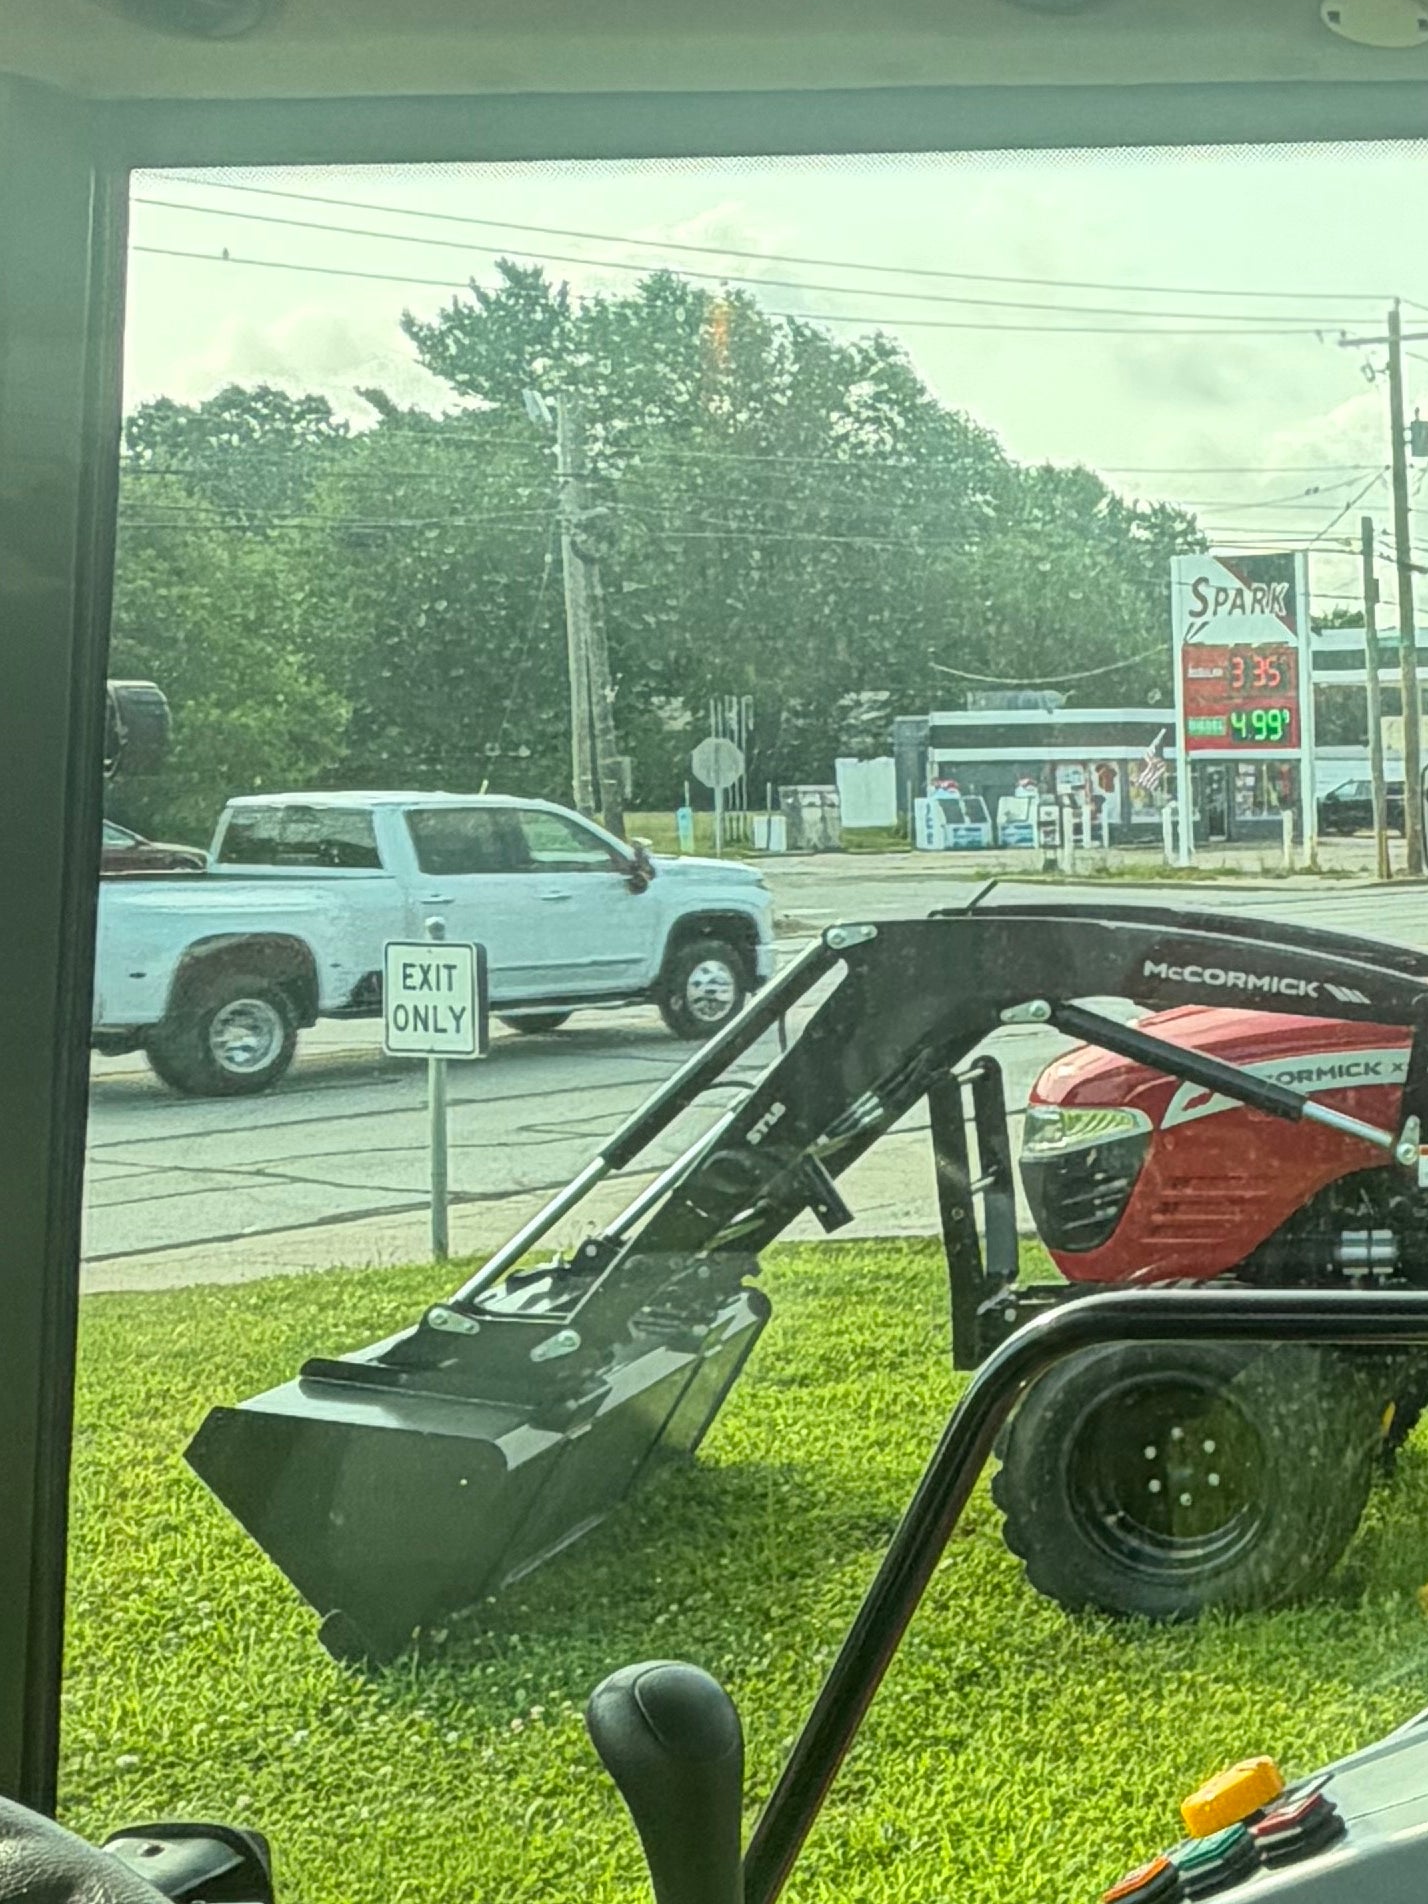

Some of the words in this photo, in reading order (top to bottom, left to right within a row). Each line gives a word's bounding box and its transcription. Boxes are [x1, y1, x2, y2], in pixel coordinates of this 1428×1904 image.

[1188, 576, 1290, 618] SPARK
[402, 963, 457, 992] EXIT
[1143, 959, 1320, 998] McCORMICK
[393, 1004, 466, 1034] ONLY
[1270, 1061, 1382, 1085] ORMICK
